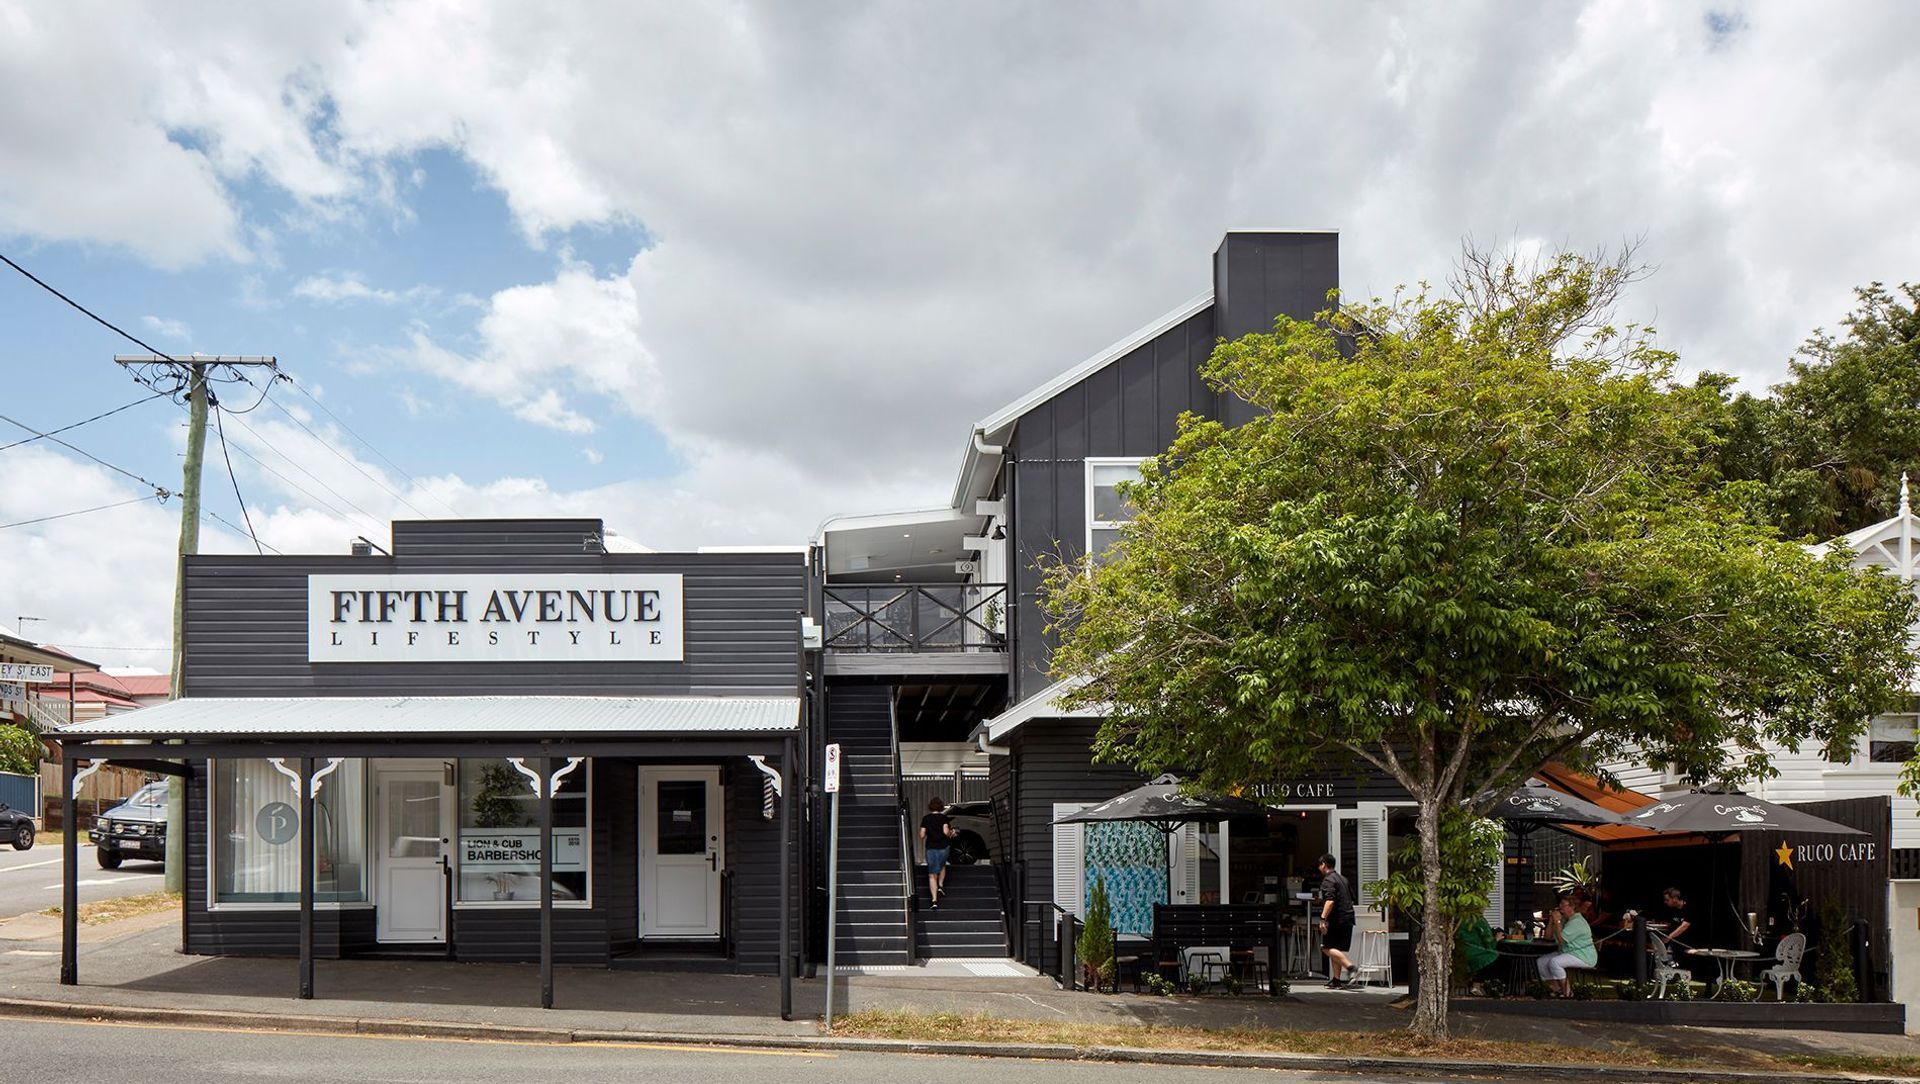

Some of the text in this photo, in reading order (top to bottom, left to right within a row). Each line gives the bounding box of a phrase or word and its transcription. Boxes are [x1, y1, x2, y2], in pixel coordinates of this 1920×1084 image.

[329, 590, 661, 623] FIFTH AVENUE
[331, 631, 662, 646] LIFESTYLE
[30, 666, 52, 677] EAST
[1297, 783, 1335, 798] CAFE
[467, 840, 523, 849] LION & CUB
[467, 850, 541, 861] BARBERSHO
[1797, 843, 1876, 862] RUCO CAFE
